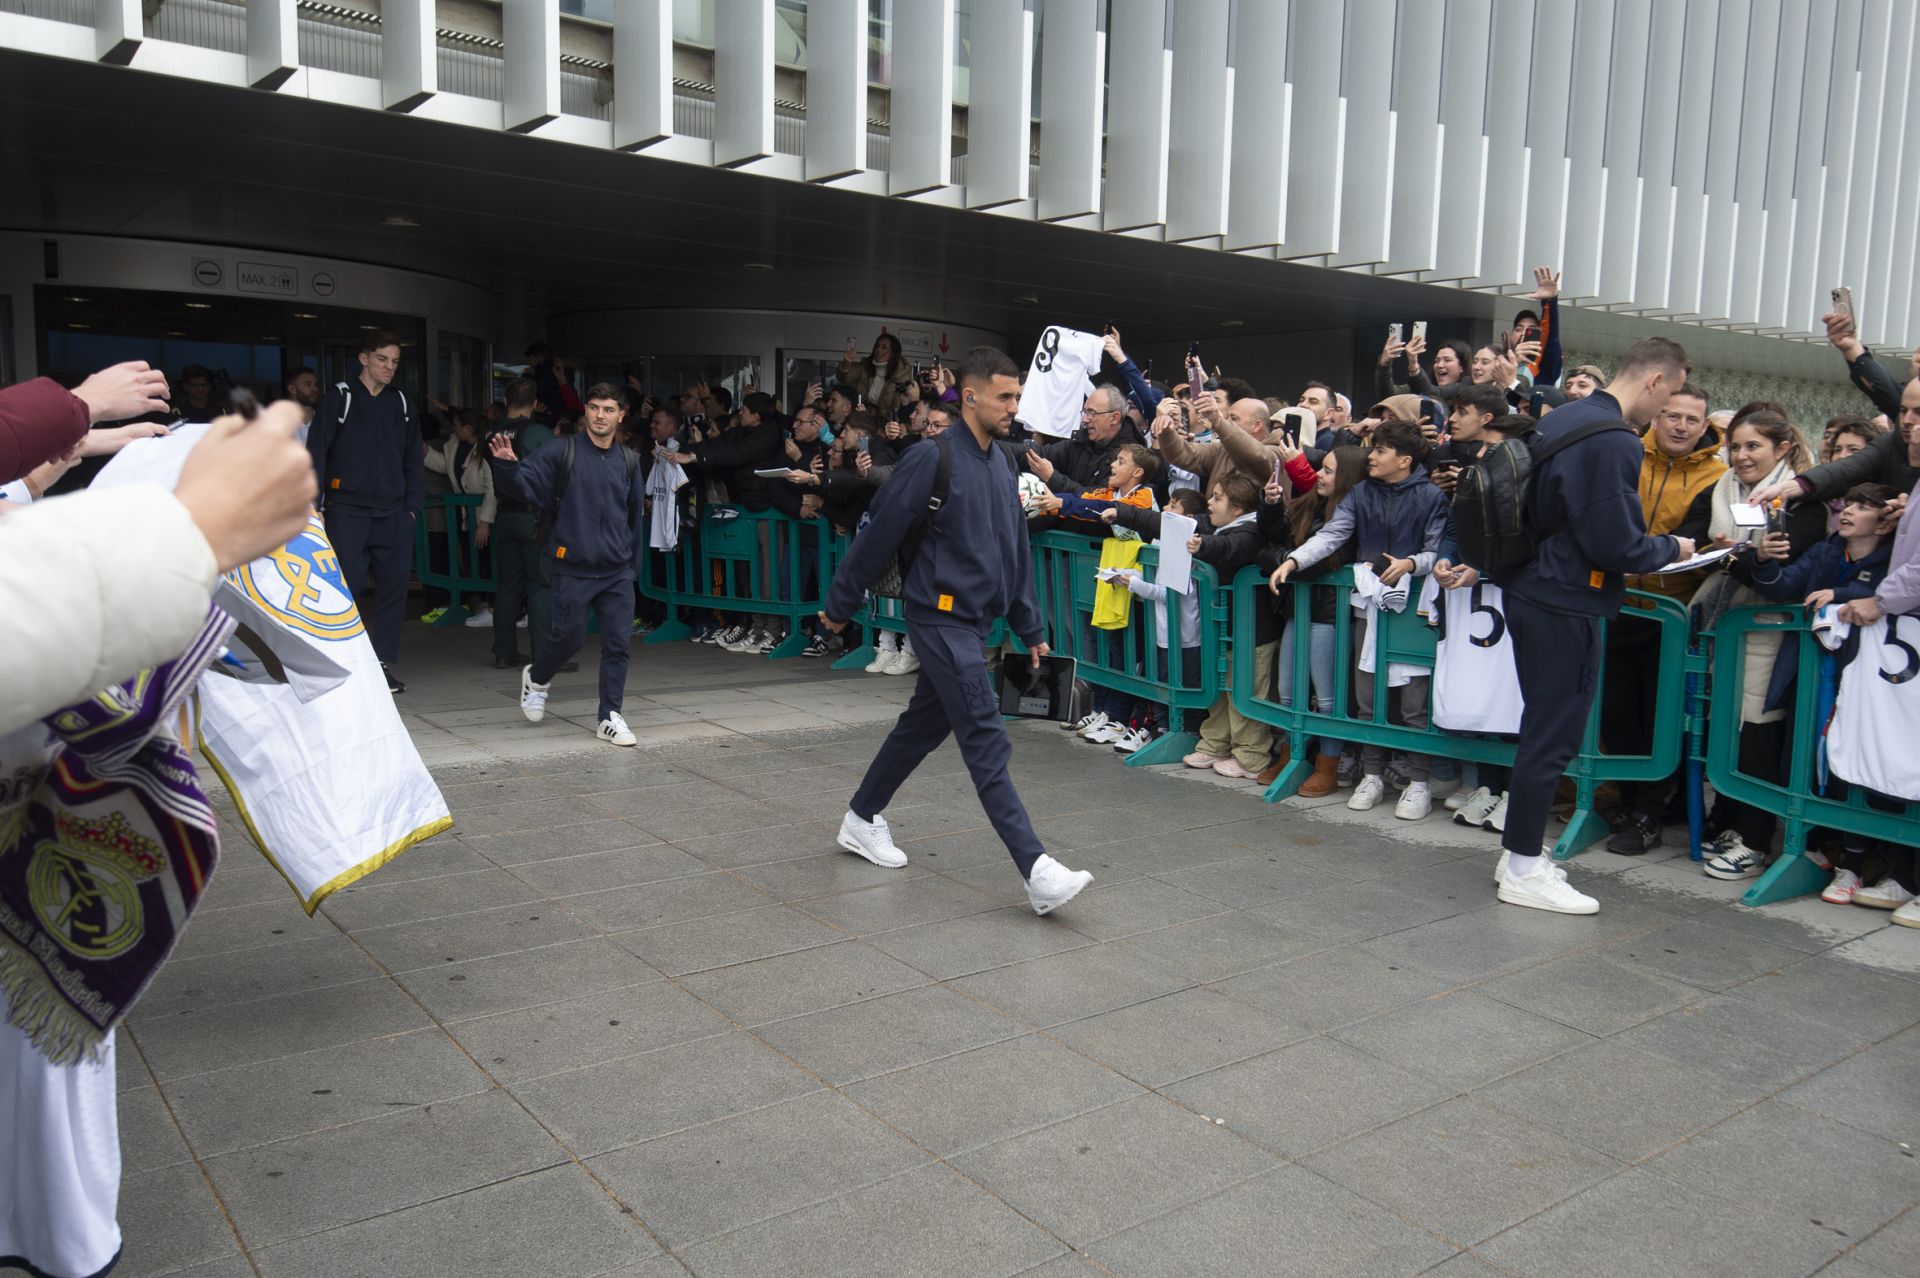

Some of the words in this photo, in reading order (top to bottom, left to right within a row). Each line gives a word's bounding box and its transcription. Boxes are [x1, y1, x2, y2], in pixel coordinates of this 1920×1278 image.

[241, 272, 269, 286] MAX.
[270, 275, 278, 287] 2
[1035, 327, 1061, 373] 9
[1469, 578, 1506, 648] 5
[1878, 613, 1920, 685] 5
[0, 902, 36, 944] eal
[29, 930, 116, 1025] Madrid
